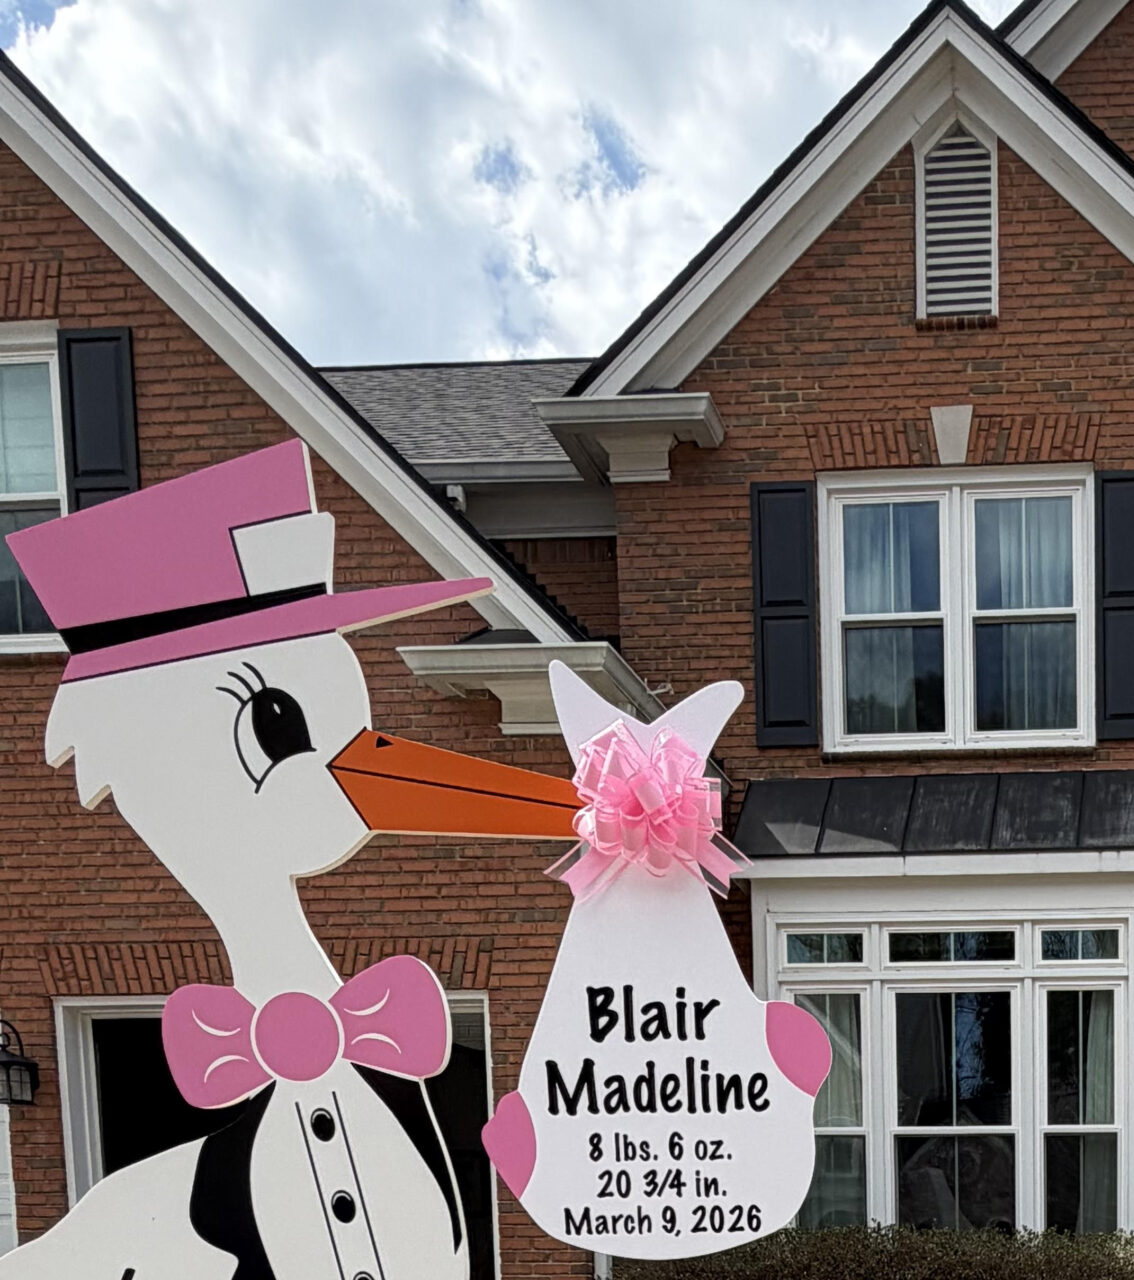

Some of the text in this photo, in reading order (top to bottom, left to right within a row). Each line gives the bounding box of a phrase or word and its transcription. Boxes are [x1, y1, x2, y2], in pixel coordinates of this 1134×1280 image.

[585, 984, 721, 1043] Blair
[544, 1056, 771, 1116] Madeline
[588, 1131, 732, 1162] 8 lbs. 6 oz.
[596, 1168, 727, 1199] 20 3/4 in.
[563, 1204, 762, 1237] March 9, 2026
